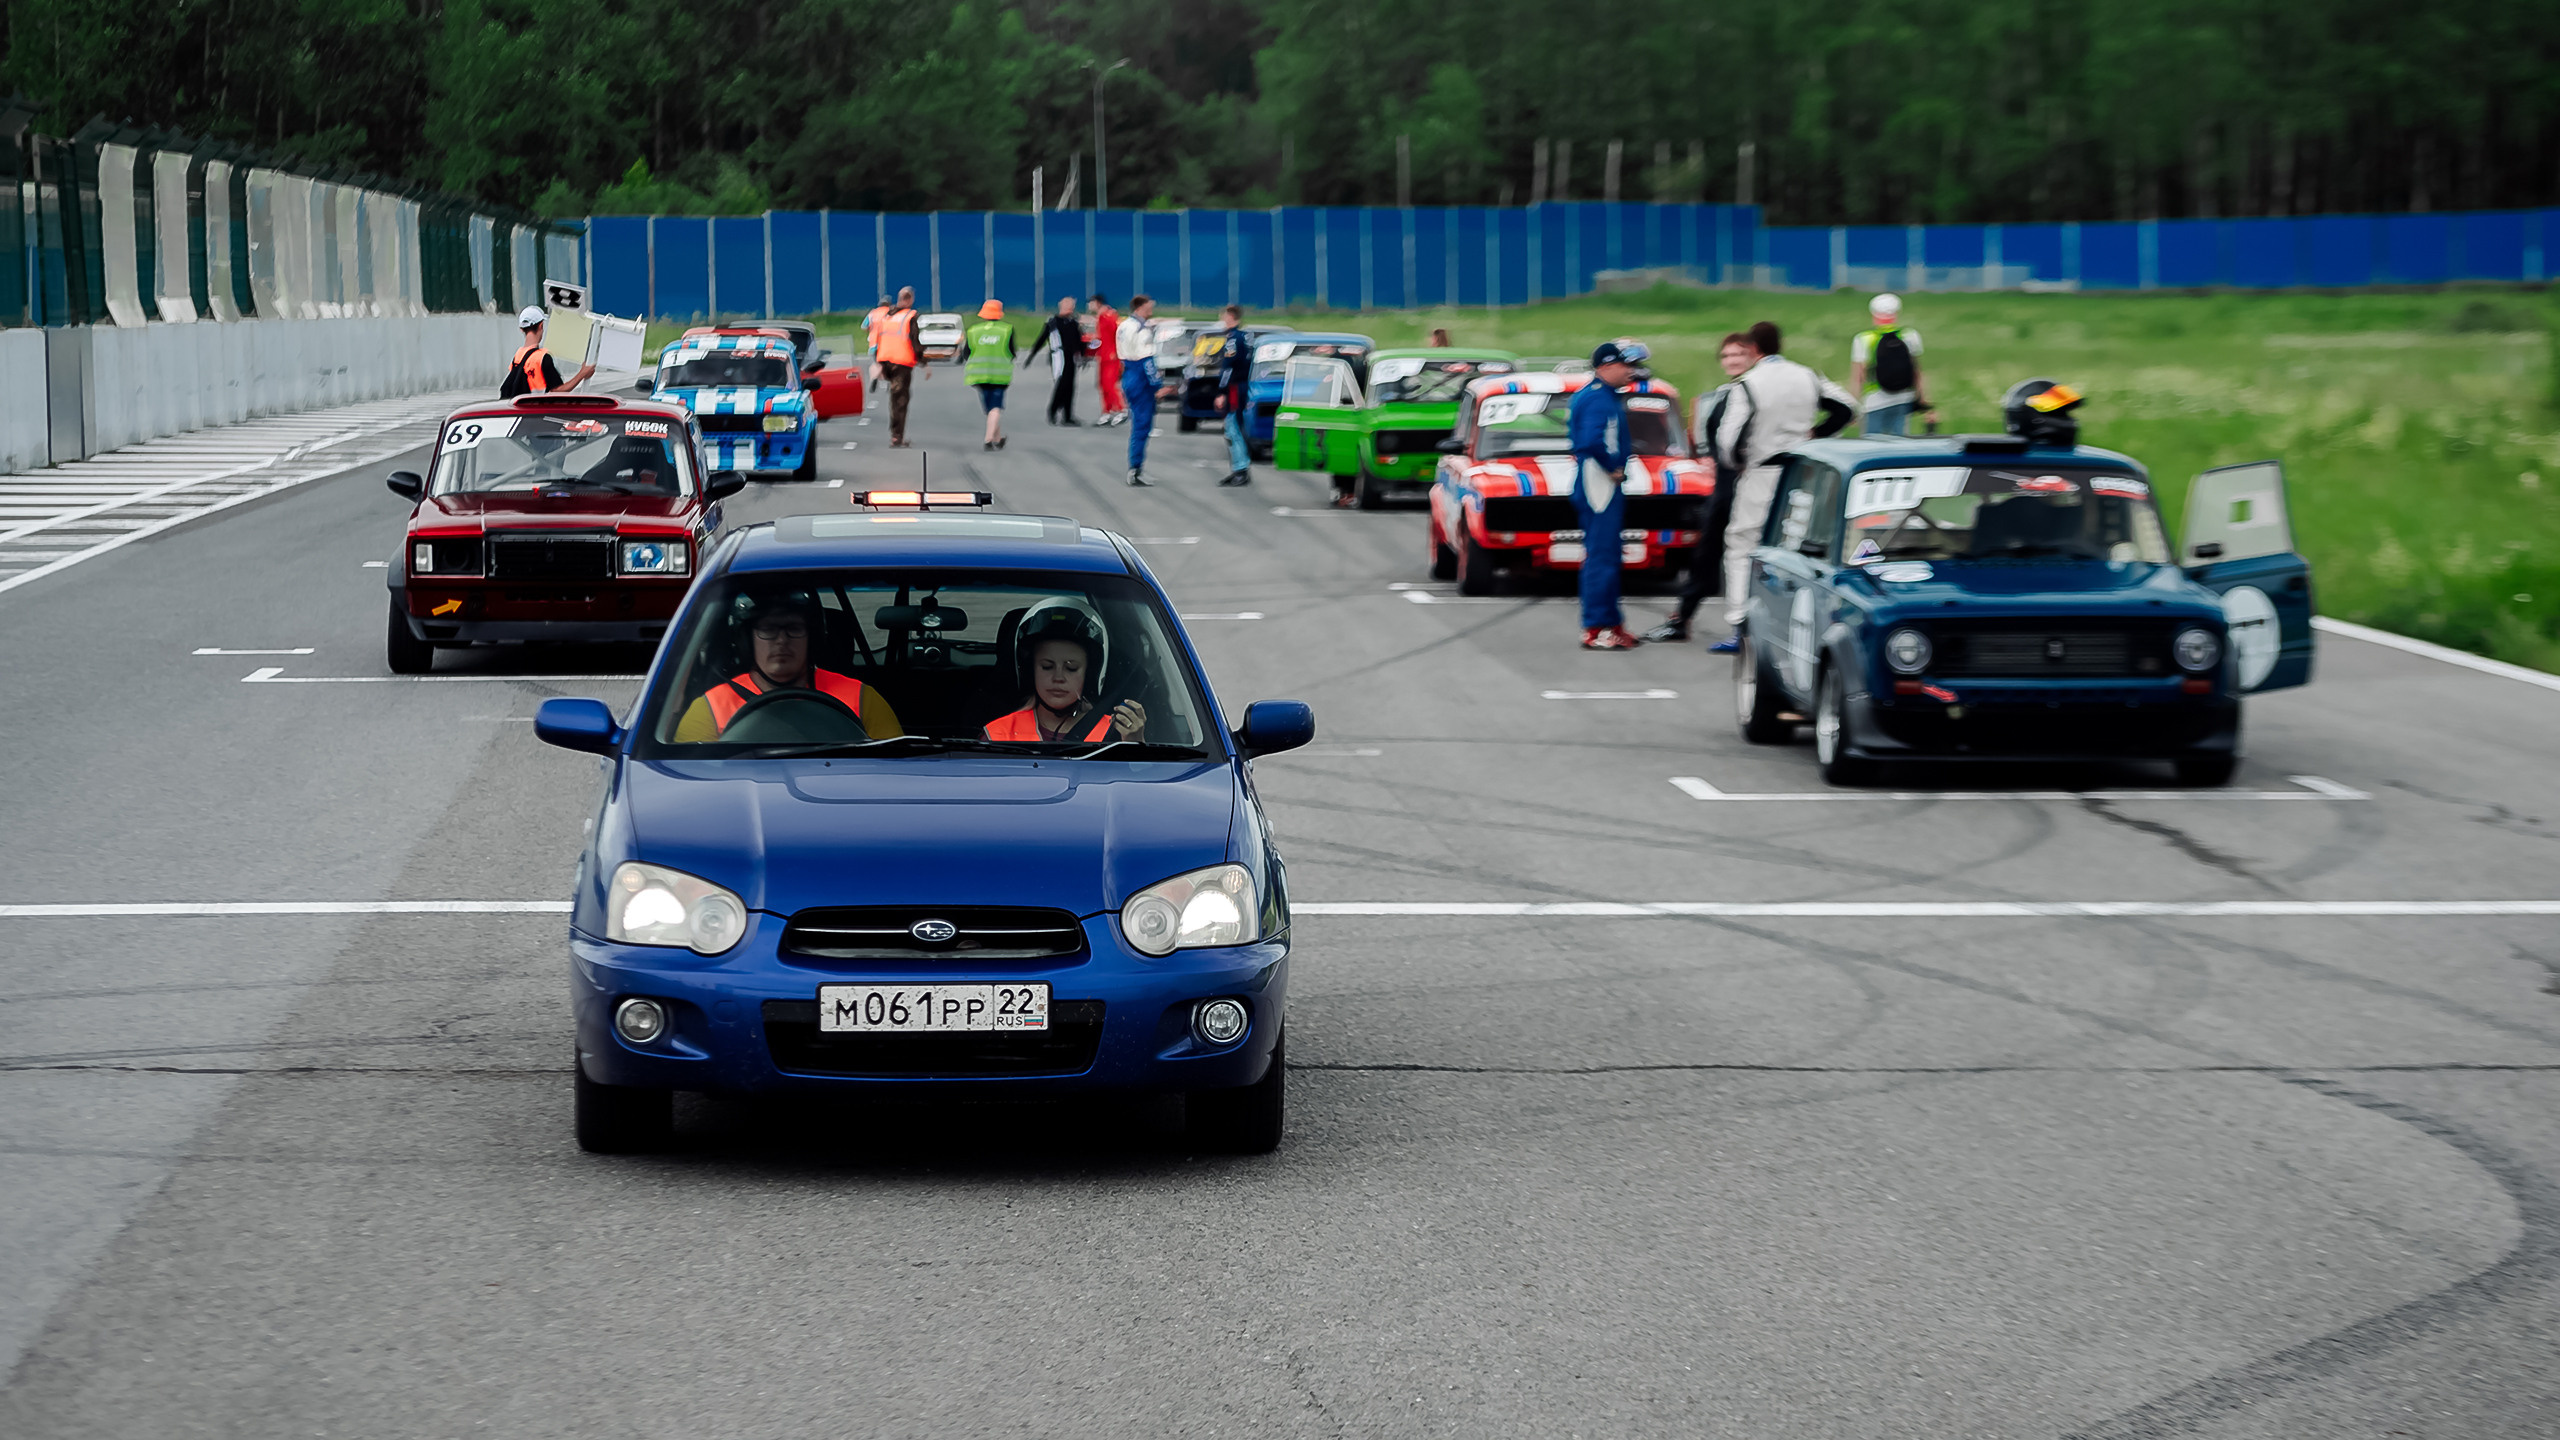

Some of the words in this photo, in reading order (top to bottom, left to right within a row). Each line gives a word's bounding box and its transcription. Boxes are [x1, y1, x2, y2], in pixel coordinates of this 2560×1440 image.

[447, 424, 483, 444] 69
[998, 988, 1034, 1014] 22
[997, 1016, 1023, 1026] RUS
